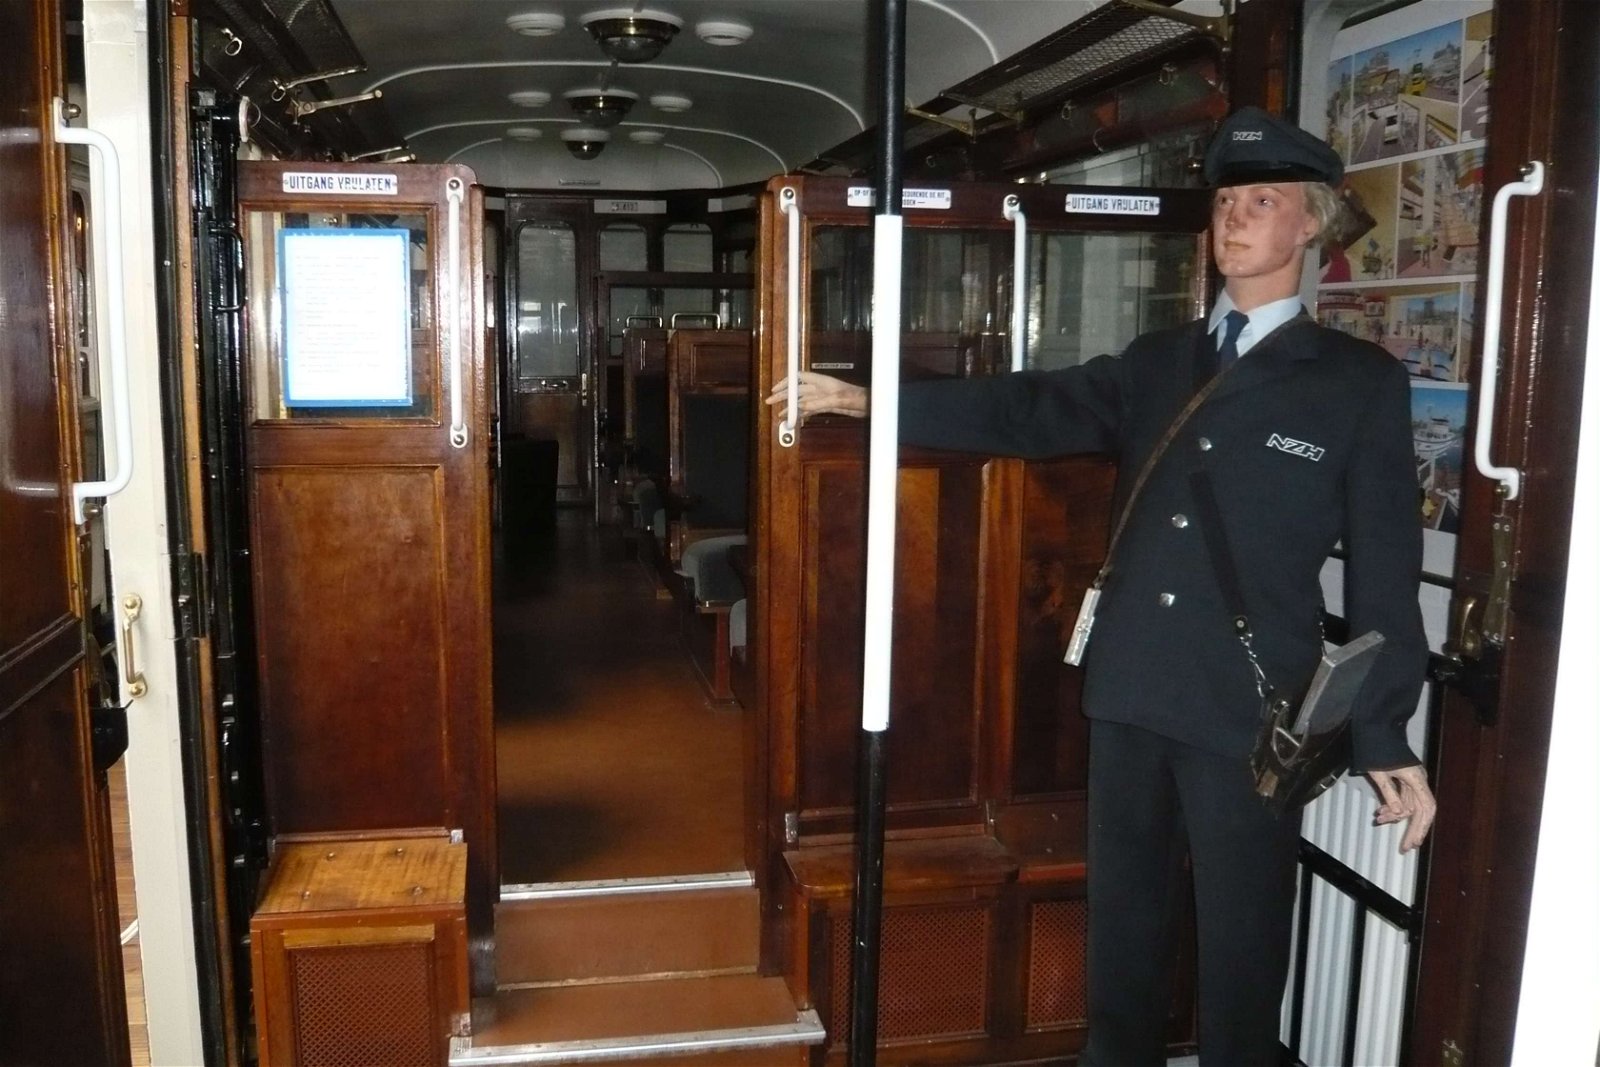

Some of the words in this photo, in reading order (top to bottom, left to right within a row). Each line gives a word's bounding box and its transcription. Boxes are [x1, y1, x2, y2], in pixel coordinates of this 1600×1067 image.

[289, 175, 334, 190] UITGANG
[1071, 197, 1109, 210] UITGANG
[1266, 433, 1325, 462] NZH
